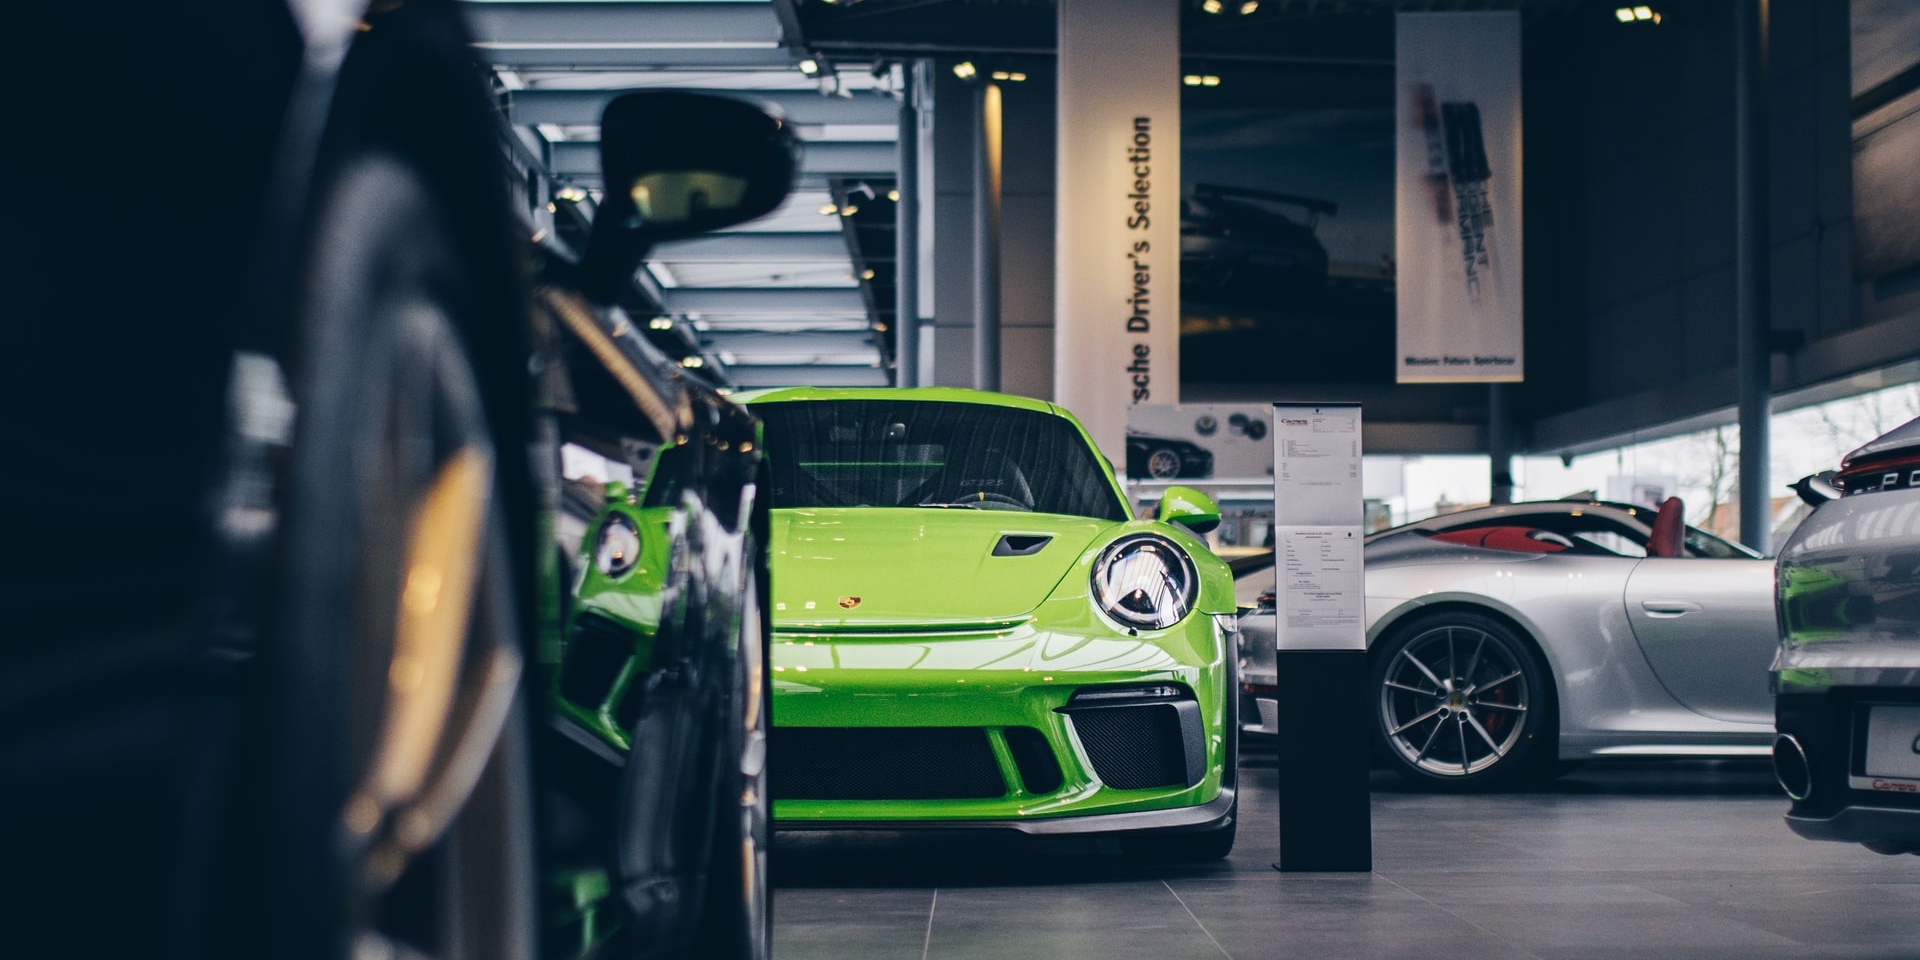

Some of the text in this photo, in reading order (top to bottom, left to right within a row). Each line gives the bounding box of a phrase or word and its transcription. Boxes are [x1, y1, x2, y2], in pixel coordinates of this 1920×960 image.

[1127, 117, 1151, 404] sche Driver's Selection
